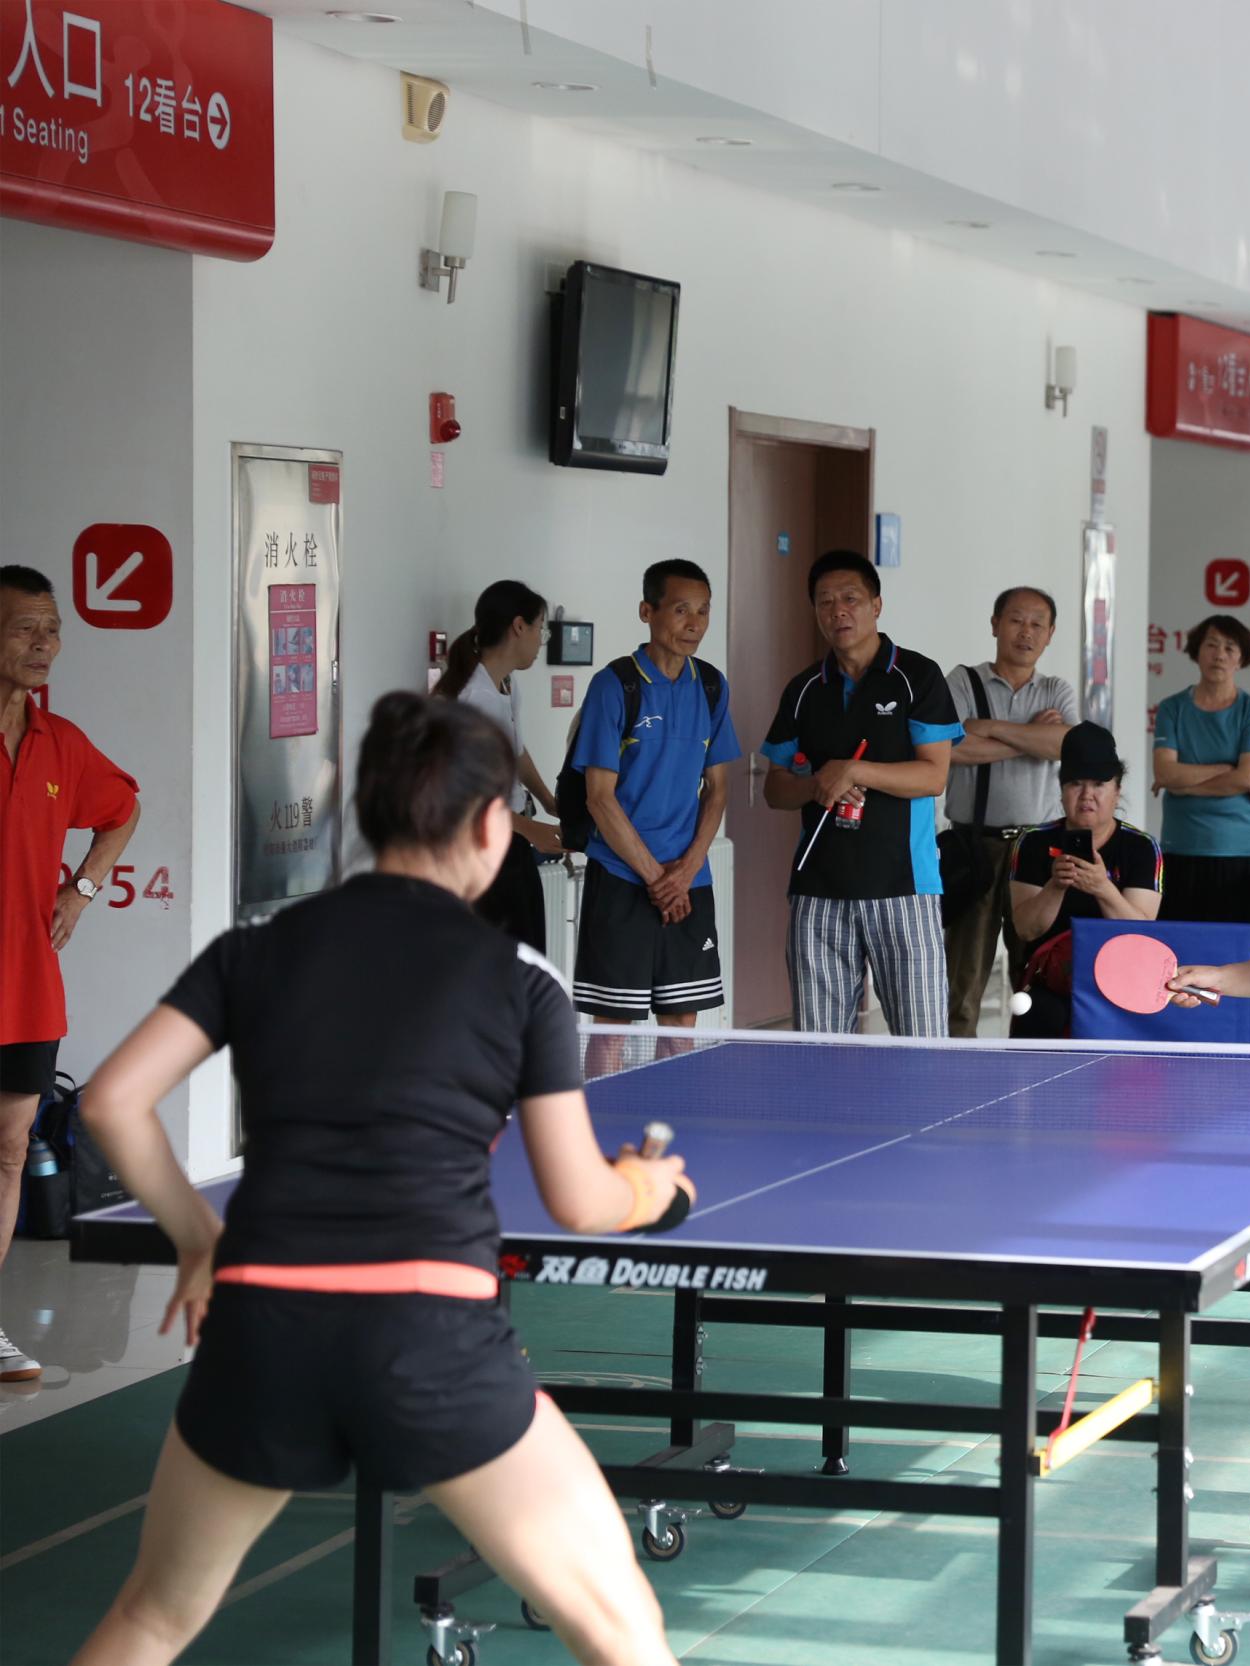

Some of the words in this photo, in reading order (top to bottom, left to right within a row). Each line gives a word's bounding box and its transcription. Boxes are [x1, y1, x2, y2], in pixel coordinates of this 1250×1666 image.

[124, 73, 202, 142] 12看台
[13, 106, 89, 164] Seating
[264, 531, 318, 568] 消火栓
[610, 1257, 709, 1287] DOUBLE
[709, 1265, 767, 1291] FISH
